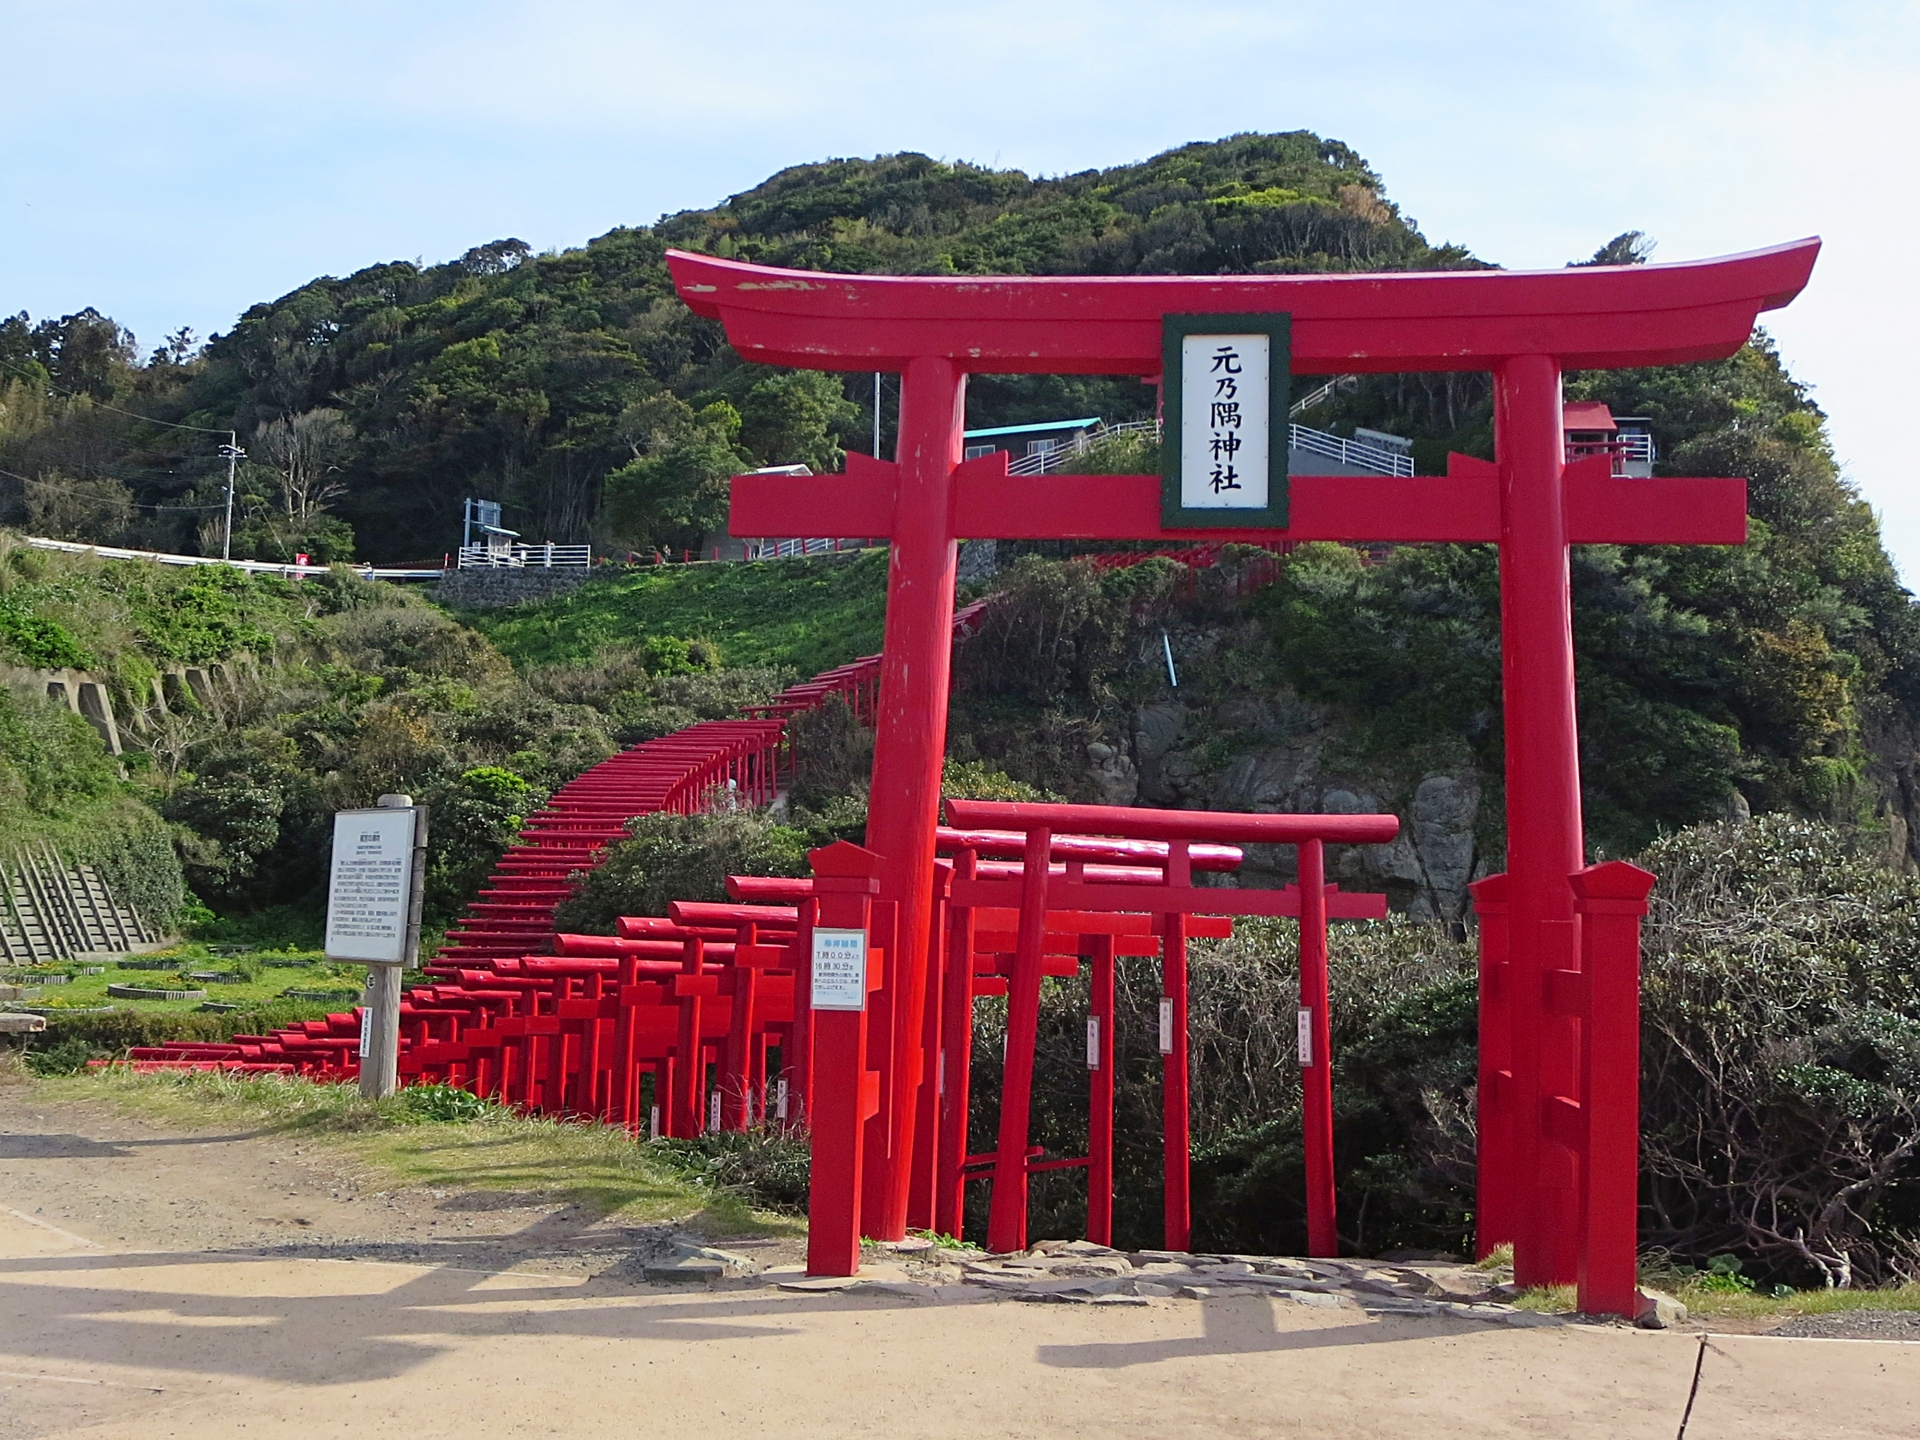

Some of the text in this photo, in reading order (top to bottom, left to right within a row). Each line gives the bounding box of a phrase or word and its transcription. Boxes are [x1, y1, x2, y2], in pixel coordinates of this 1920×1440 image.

[1208, 345, 1242, 495] 元乃隅神社
